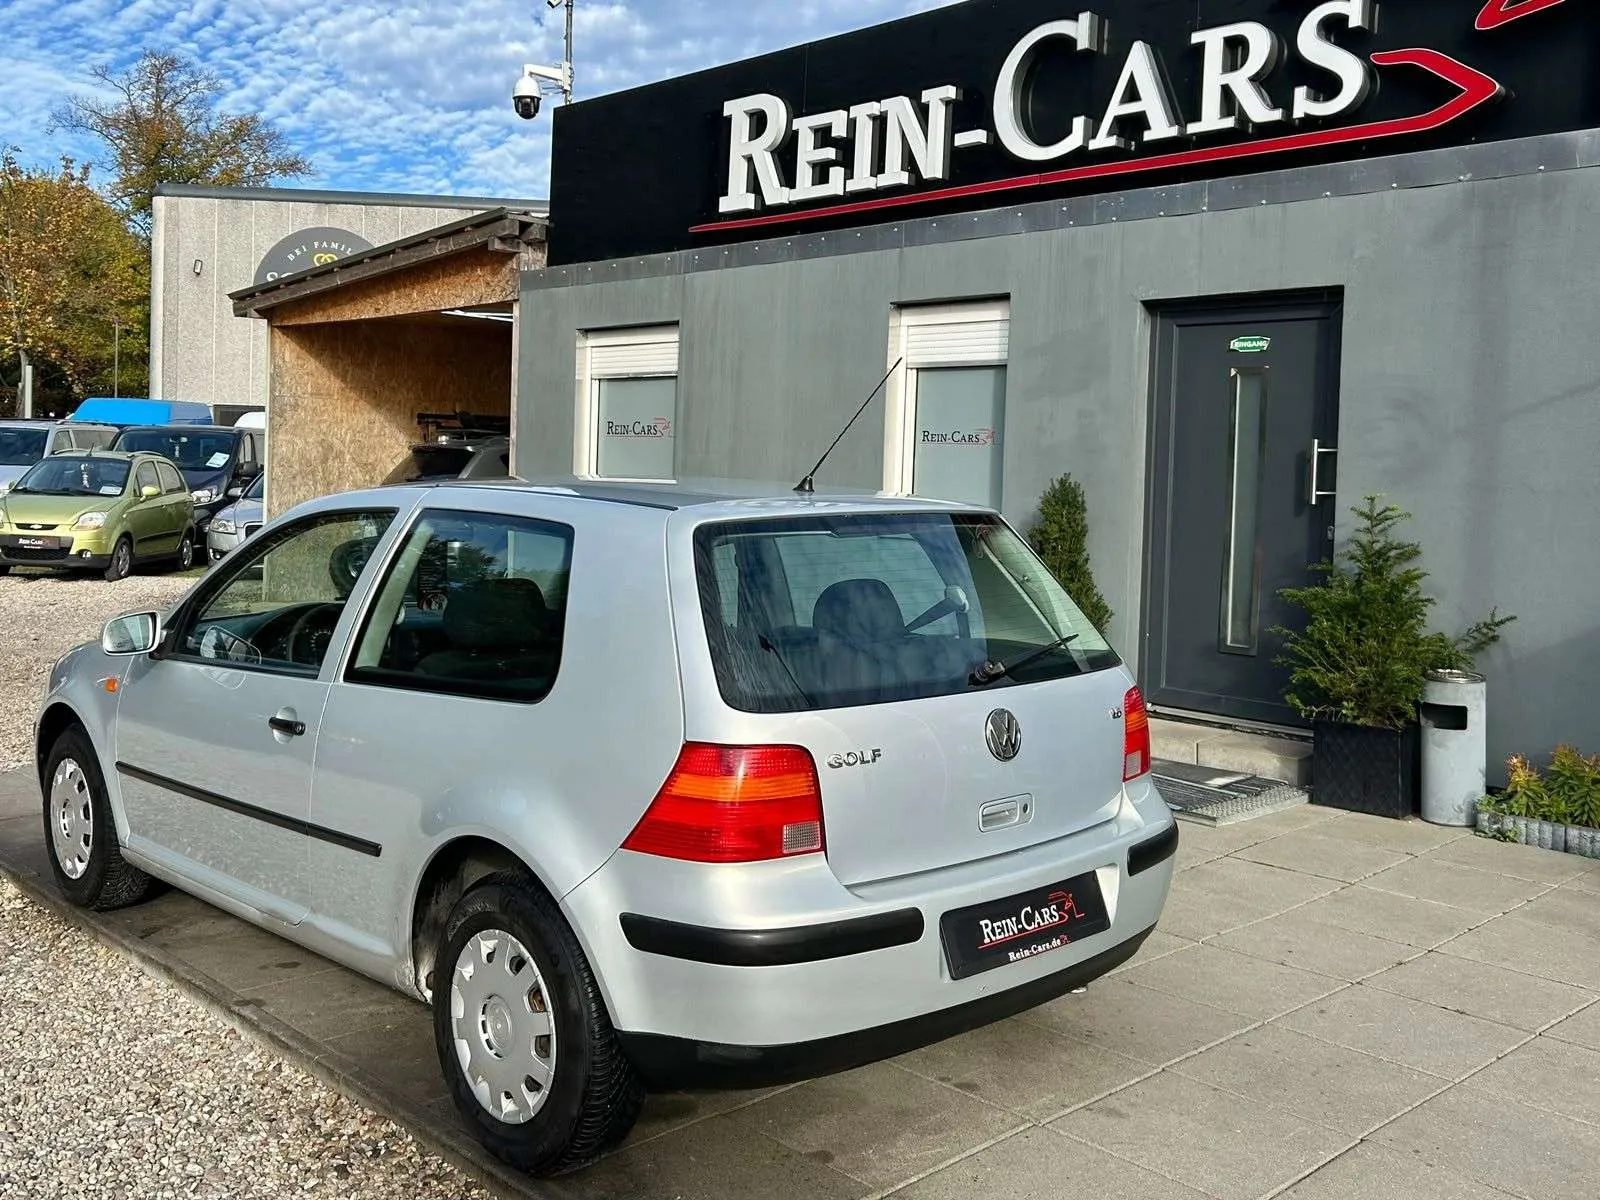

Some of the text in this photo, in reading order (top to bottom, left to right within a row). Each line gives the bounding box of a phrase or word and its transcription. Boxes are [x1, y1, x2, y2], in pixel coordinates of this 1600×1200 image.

[719, 0, 1370, 213] REIN-CARS
[287, 245, 307, 261] BEI
[606, 421, 658, 436] REIN-CARS
[921, 430, 980, 443] REIN-CARS
[827, 748, 881, 769] GOLF
[979, 904, 1060, 944] REIN-CARS
[1007, 937, 1062, 962] Rein-Cars.de
